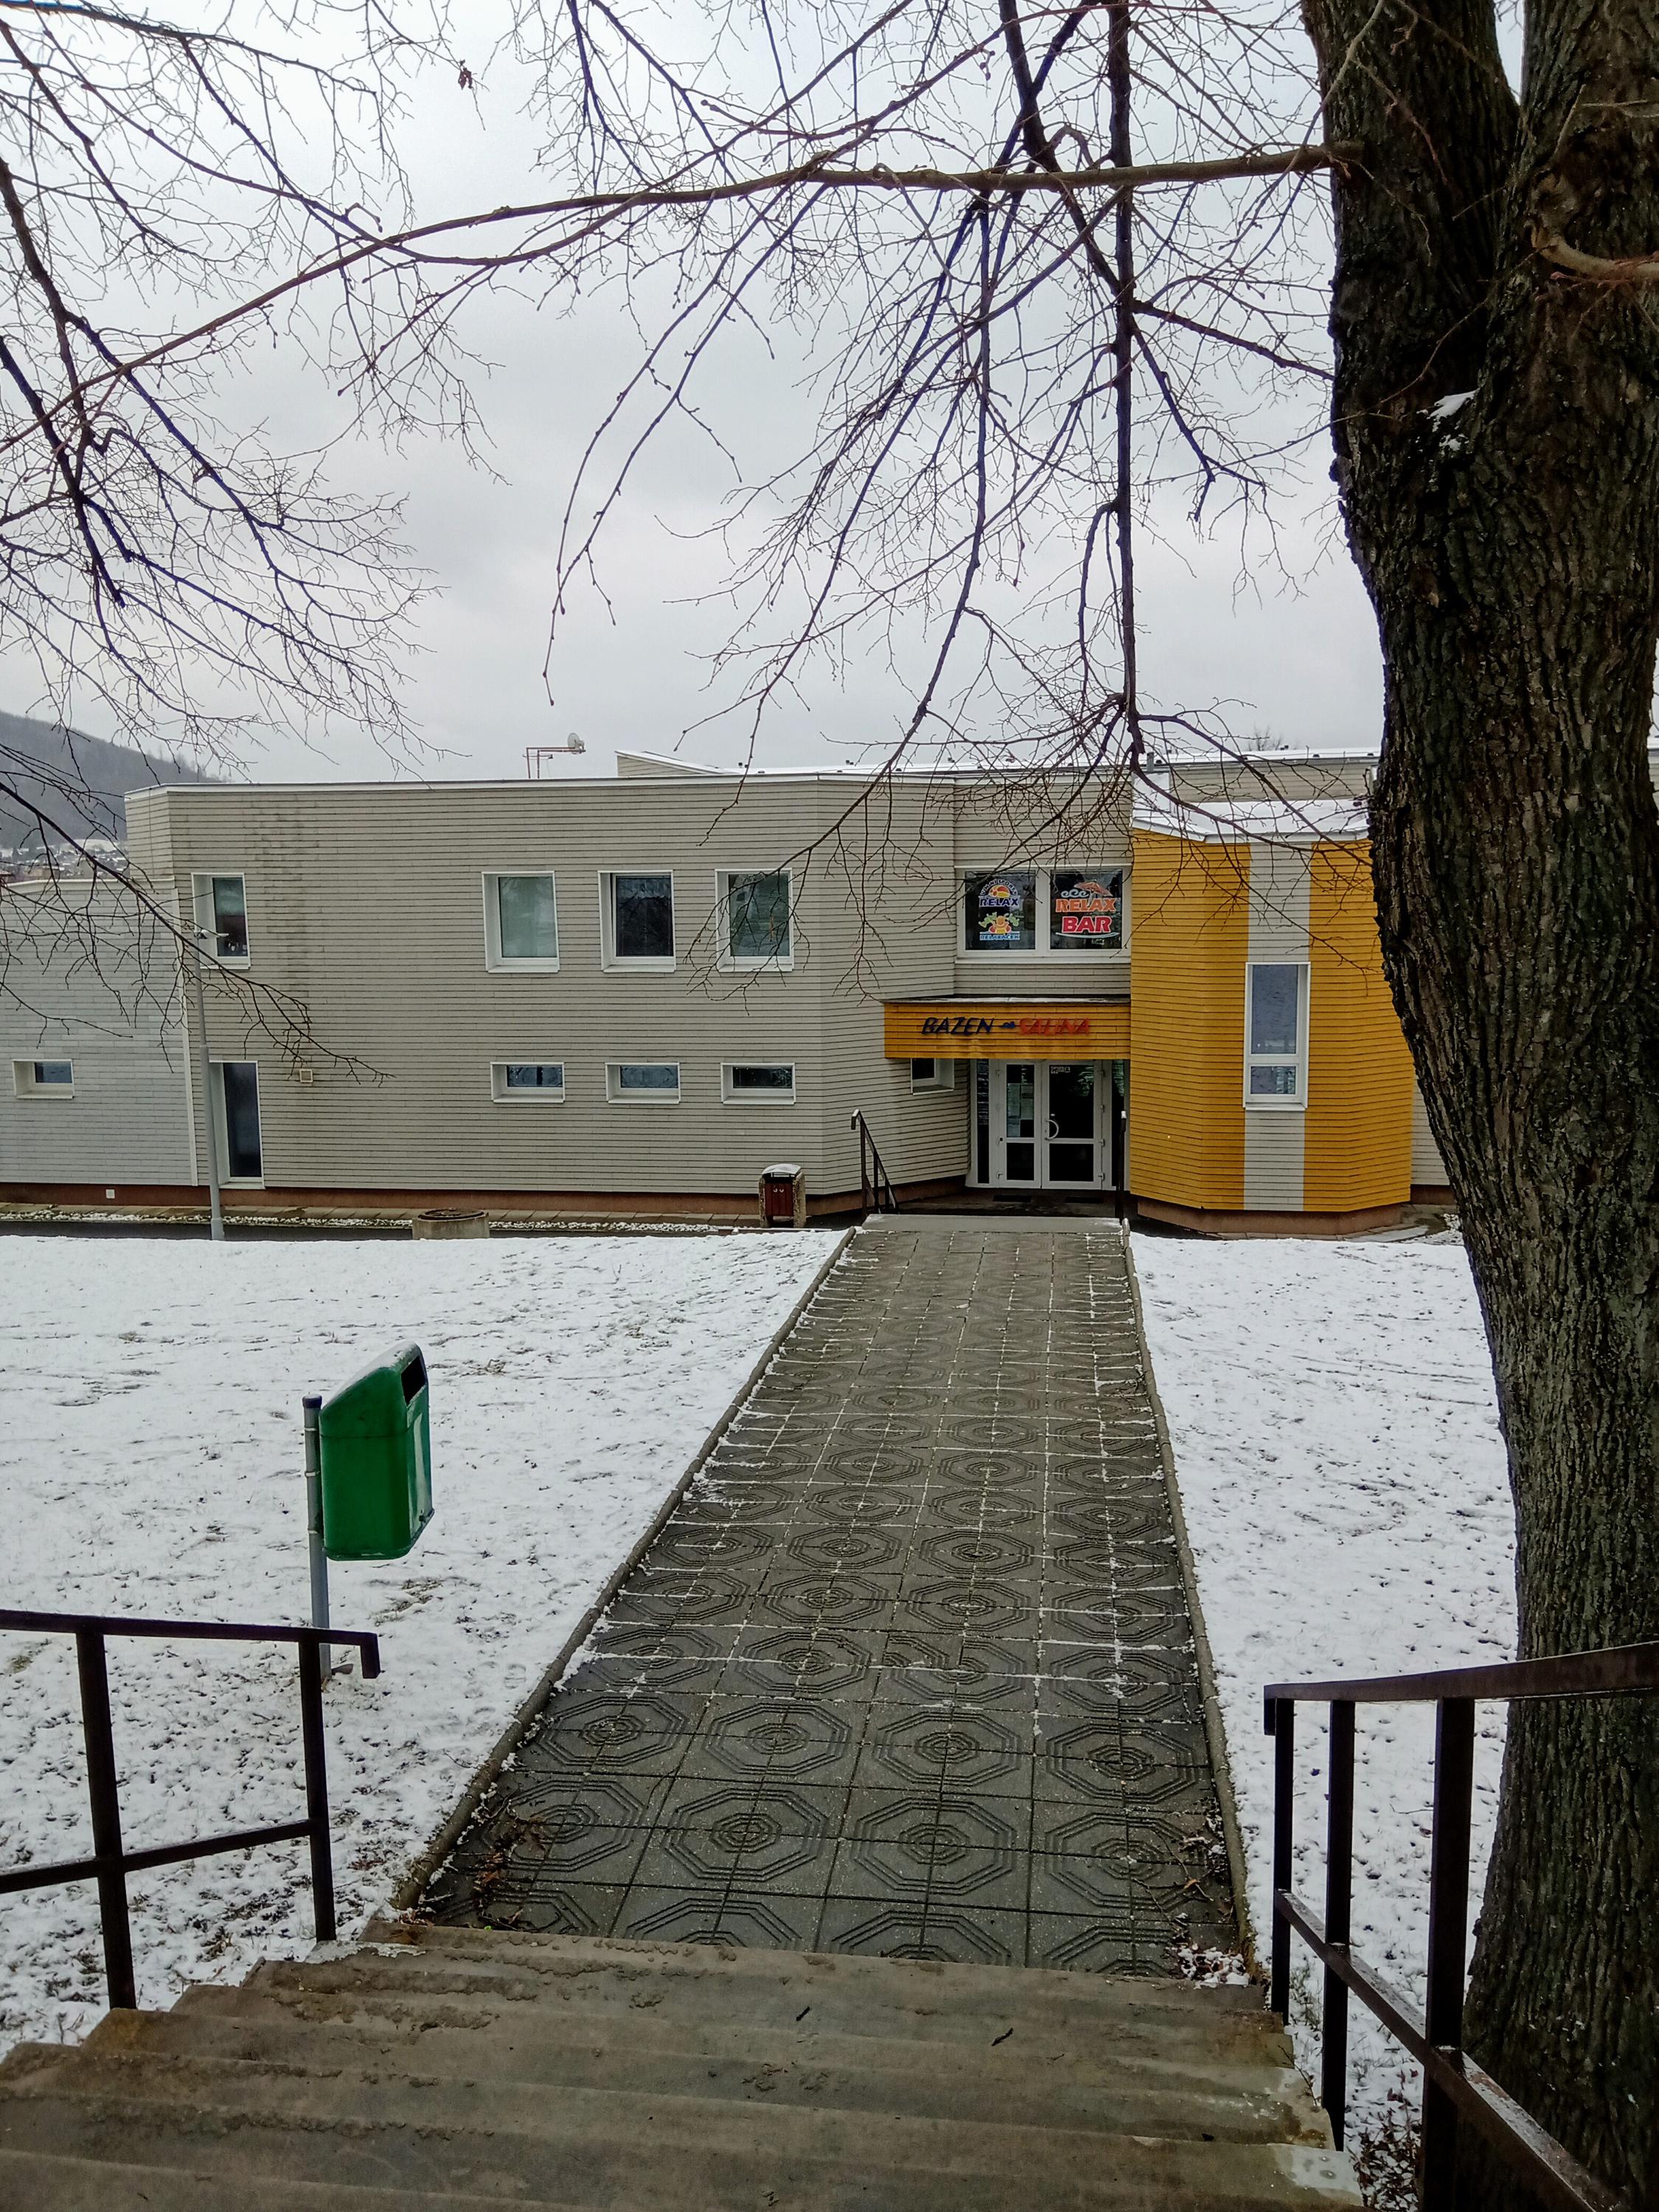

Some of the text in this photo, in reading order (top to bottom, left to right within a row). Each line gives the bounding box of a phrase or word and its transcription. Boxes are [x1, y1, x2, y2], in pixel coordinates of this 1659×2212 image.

[980, 898, 1019, 906] RELAX
[1055, 898, 1116, 913] RELAX
[1062, 916, 1112, 933] BAR
[1018, 1018, 1089, 1036] SAUNA
